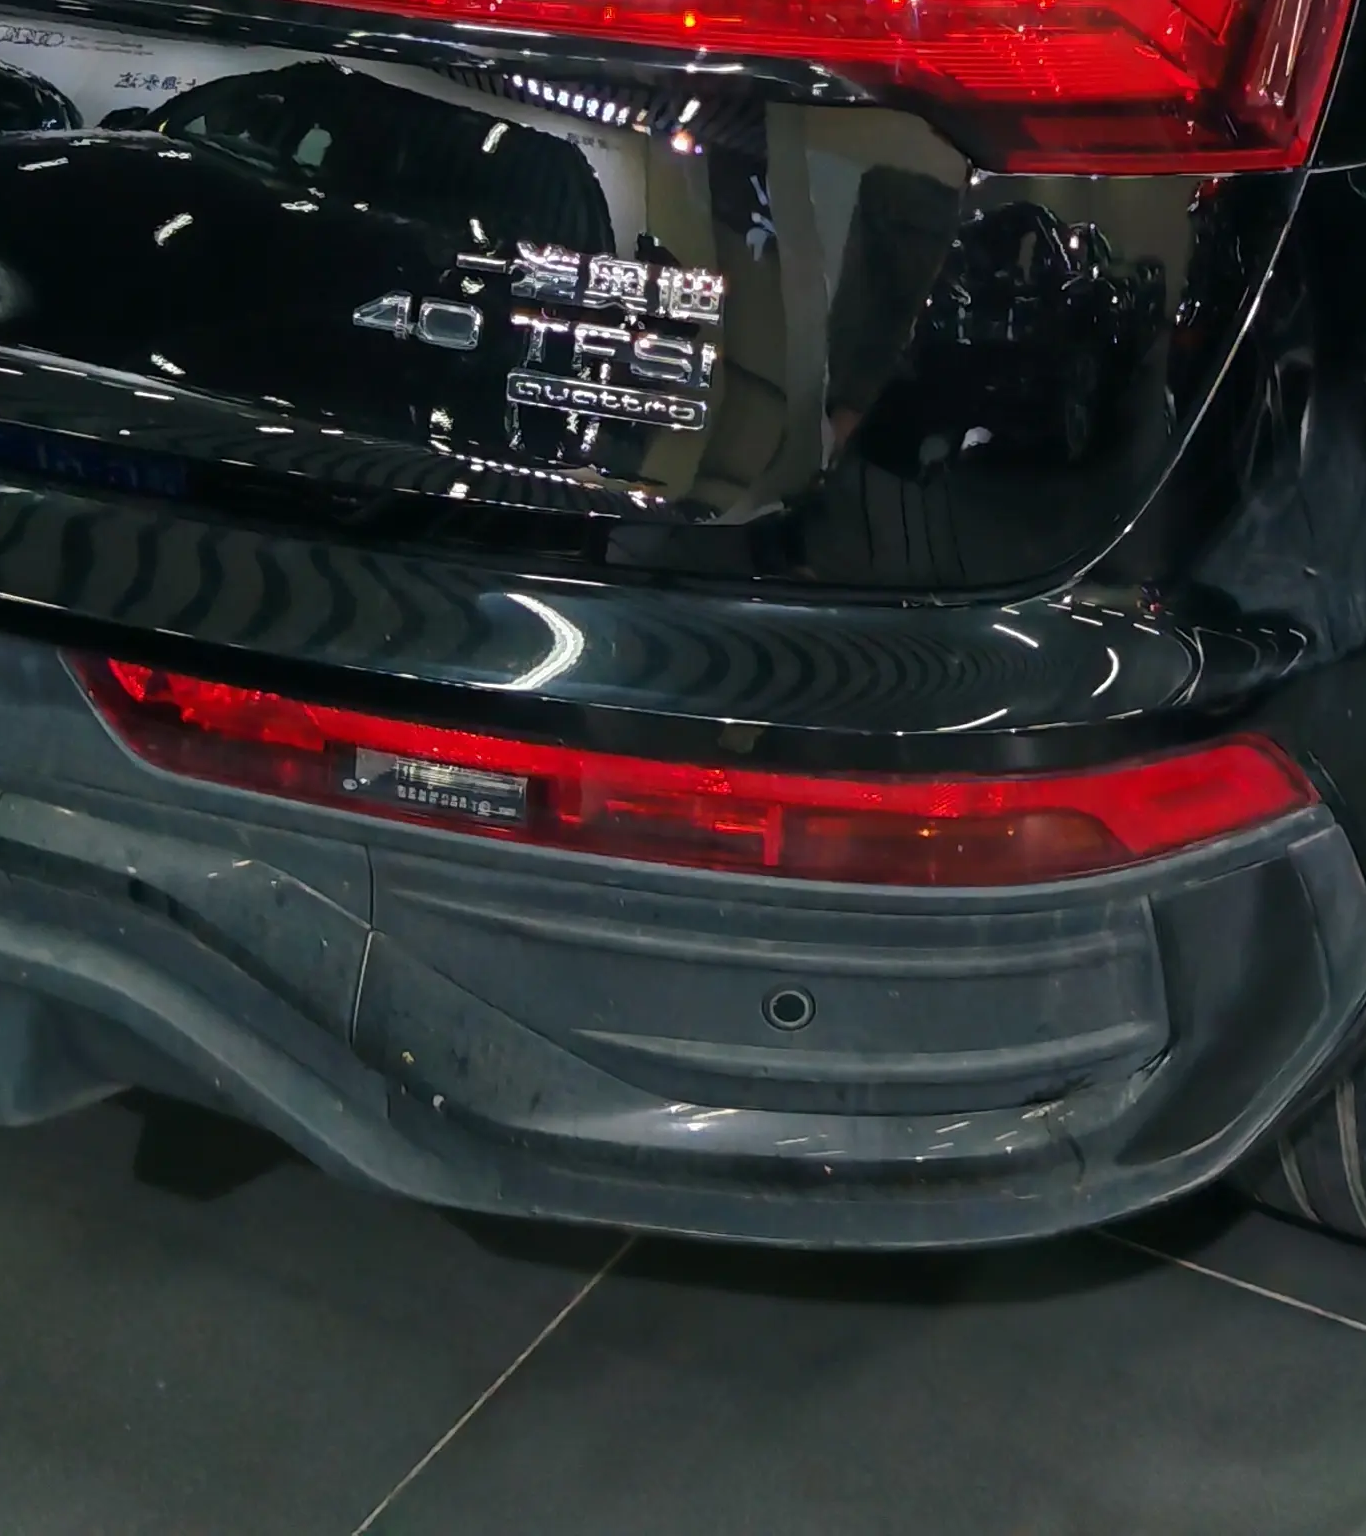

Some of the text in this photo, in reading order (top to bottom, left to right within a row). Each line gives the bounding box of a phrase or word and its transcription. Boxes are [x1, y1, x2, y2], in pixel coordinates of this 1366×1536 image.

[352, 290, 716, 389] 40 TFSI
[514, 381, 696, 421] quattro
